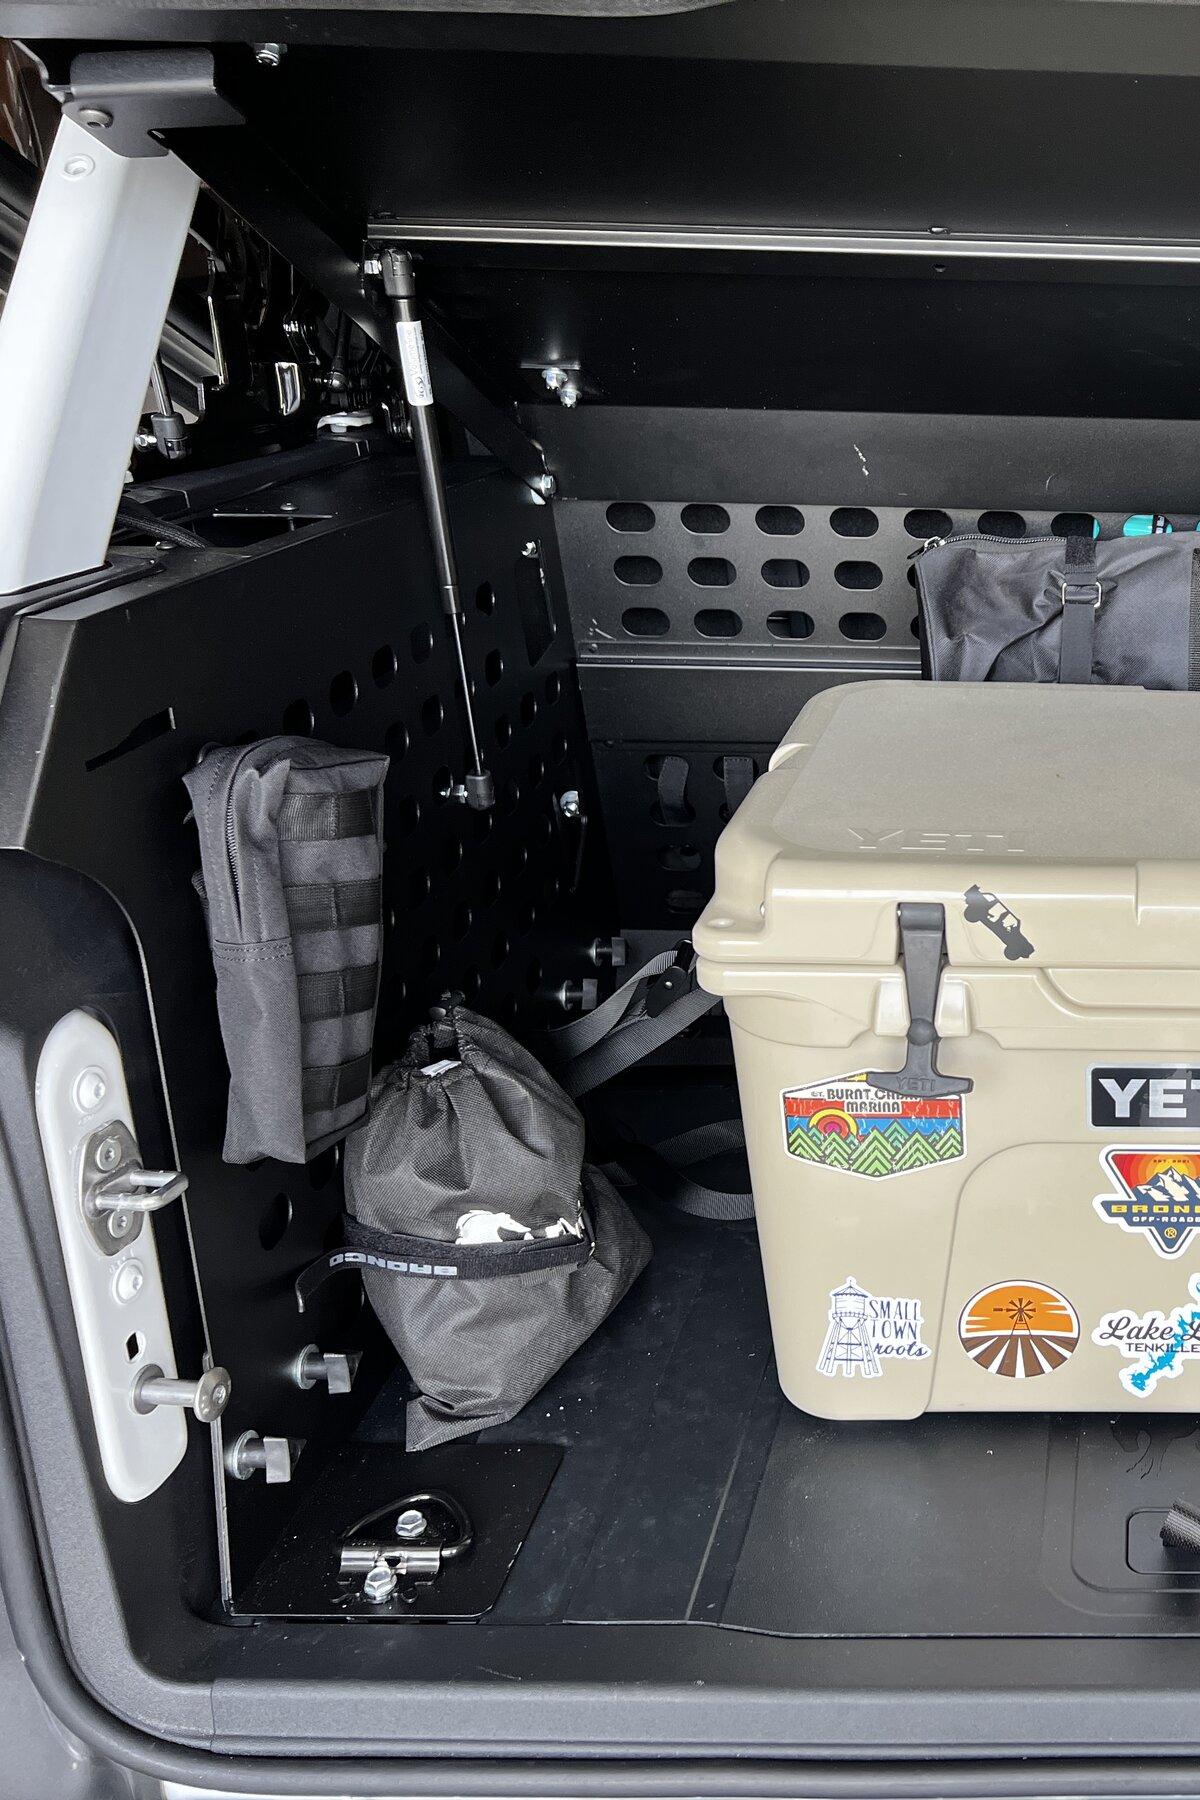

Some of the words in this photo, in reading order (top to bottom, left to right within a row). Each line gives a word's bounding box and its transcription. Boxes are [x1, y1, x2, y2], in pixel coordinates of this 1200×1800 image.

[848, 828, 1027, 852] YETI
[827, 1088, 871, 1100] BURNT
[896, 1076, 936, 1092] YETI
[846, 1101, 900, 1113] MARINA
[329, 1252, 458, 1276] BRONCO
[869, 1300, 920, 1320] SMALL
[871, 1319, 917, 1340] TOWN
[1099, 1316, 1174, 1341] Lake
[873, 1341, 928, 1357] roots
